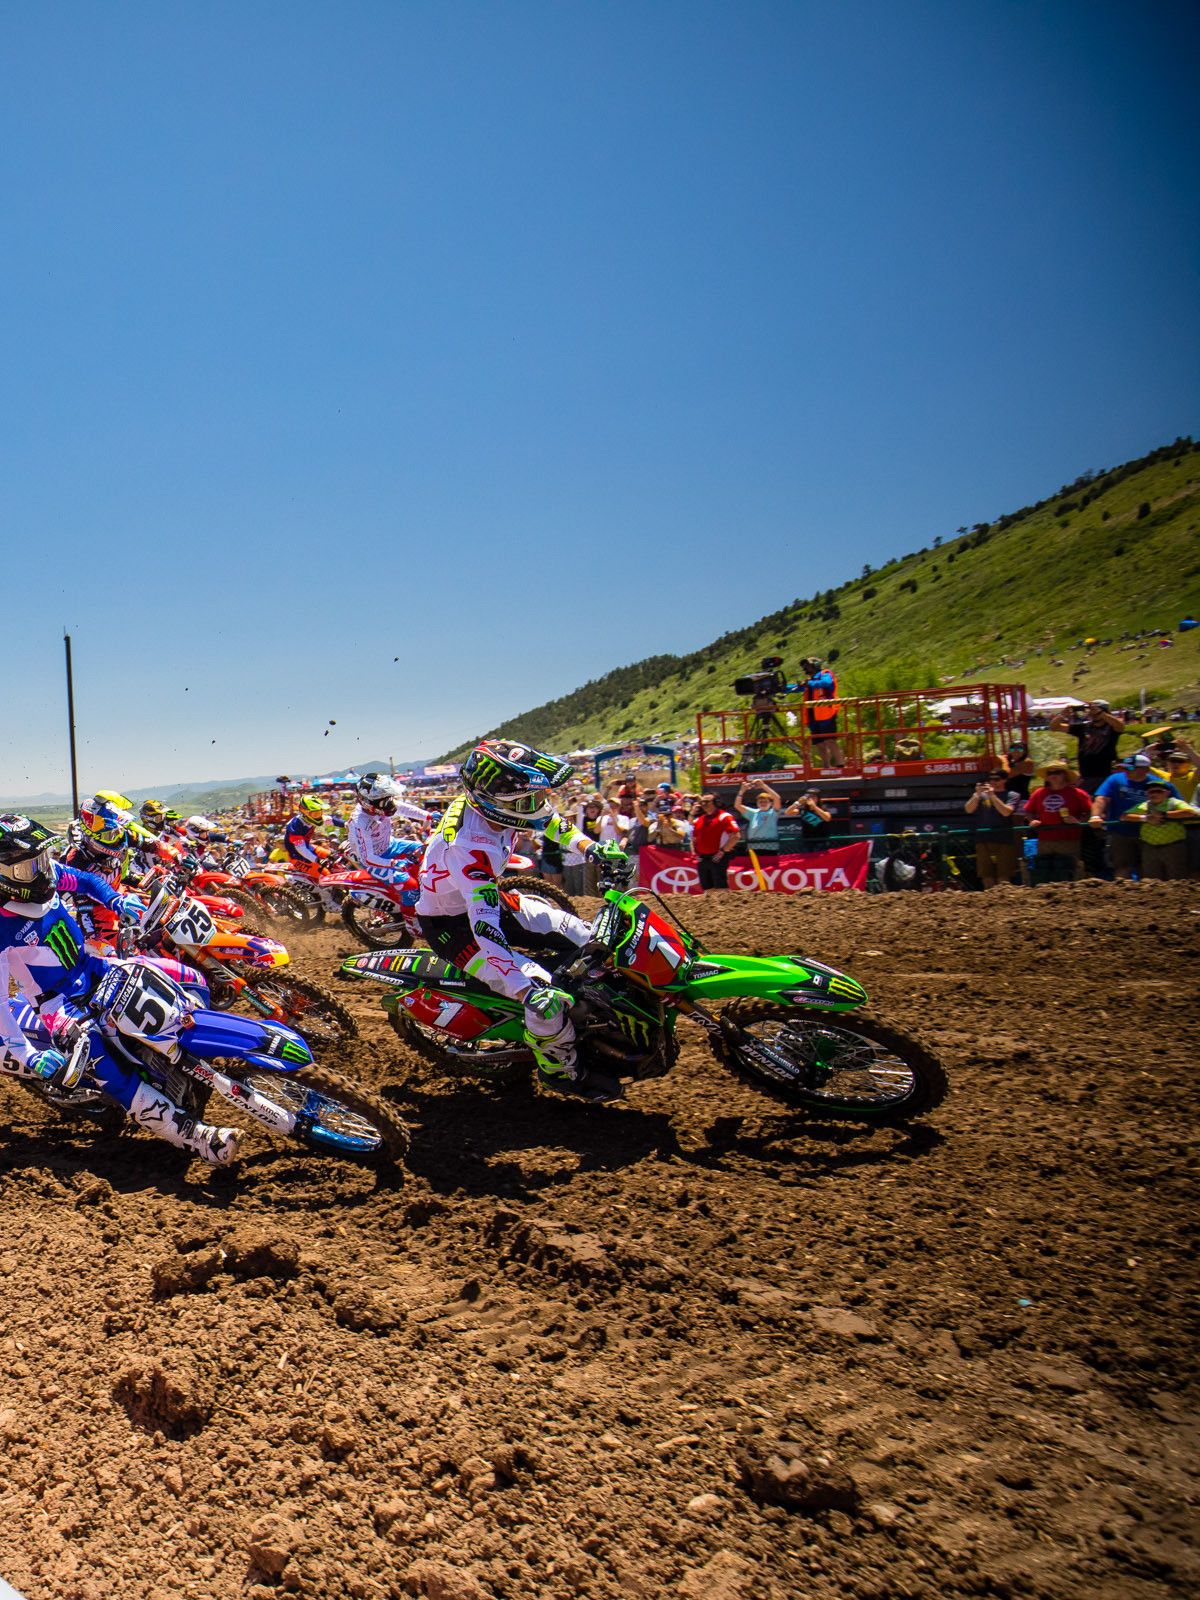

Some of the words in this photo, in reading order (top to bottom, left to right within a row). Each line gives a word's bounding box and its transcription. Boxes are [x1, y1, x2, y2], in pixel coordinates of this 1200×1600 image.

[728, 865, 850, 891] OYOTA
[362, 893, 396, 912] 718
[180, 904, 213, 944] 25
[630, 928, 643, 948] LUCAS
[648, 924, 682, 971] 1
[692, 969, 720, 980] TOMAC
[120, 984, 134, 1006] LUCAS
[122, 968, 176, 1036] 51
[433, 1001, 463, 1029] 1
[267, 1034, 281, 1055] YAMAHA
[2, 1050, 31, 1075] 5
[739, 1044, 796, 1080] DUNLOP
[182, 1065, 215, 1089] YAMA
[223, 1092, 278, 1126] DUNLOP
